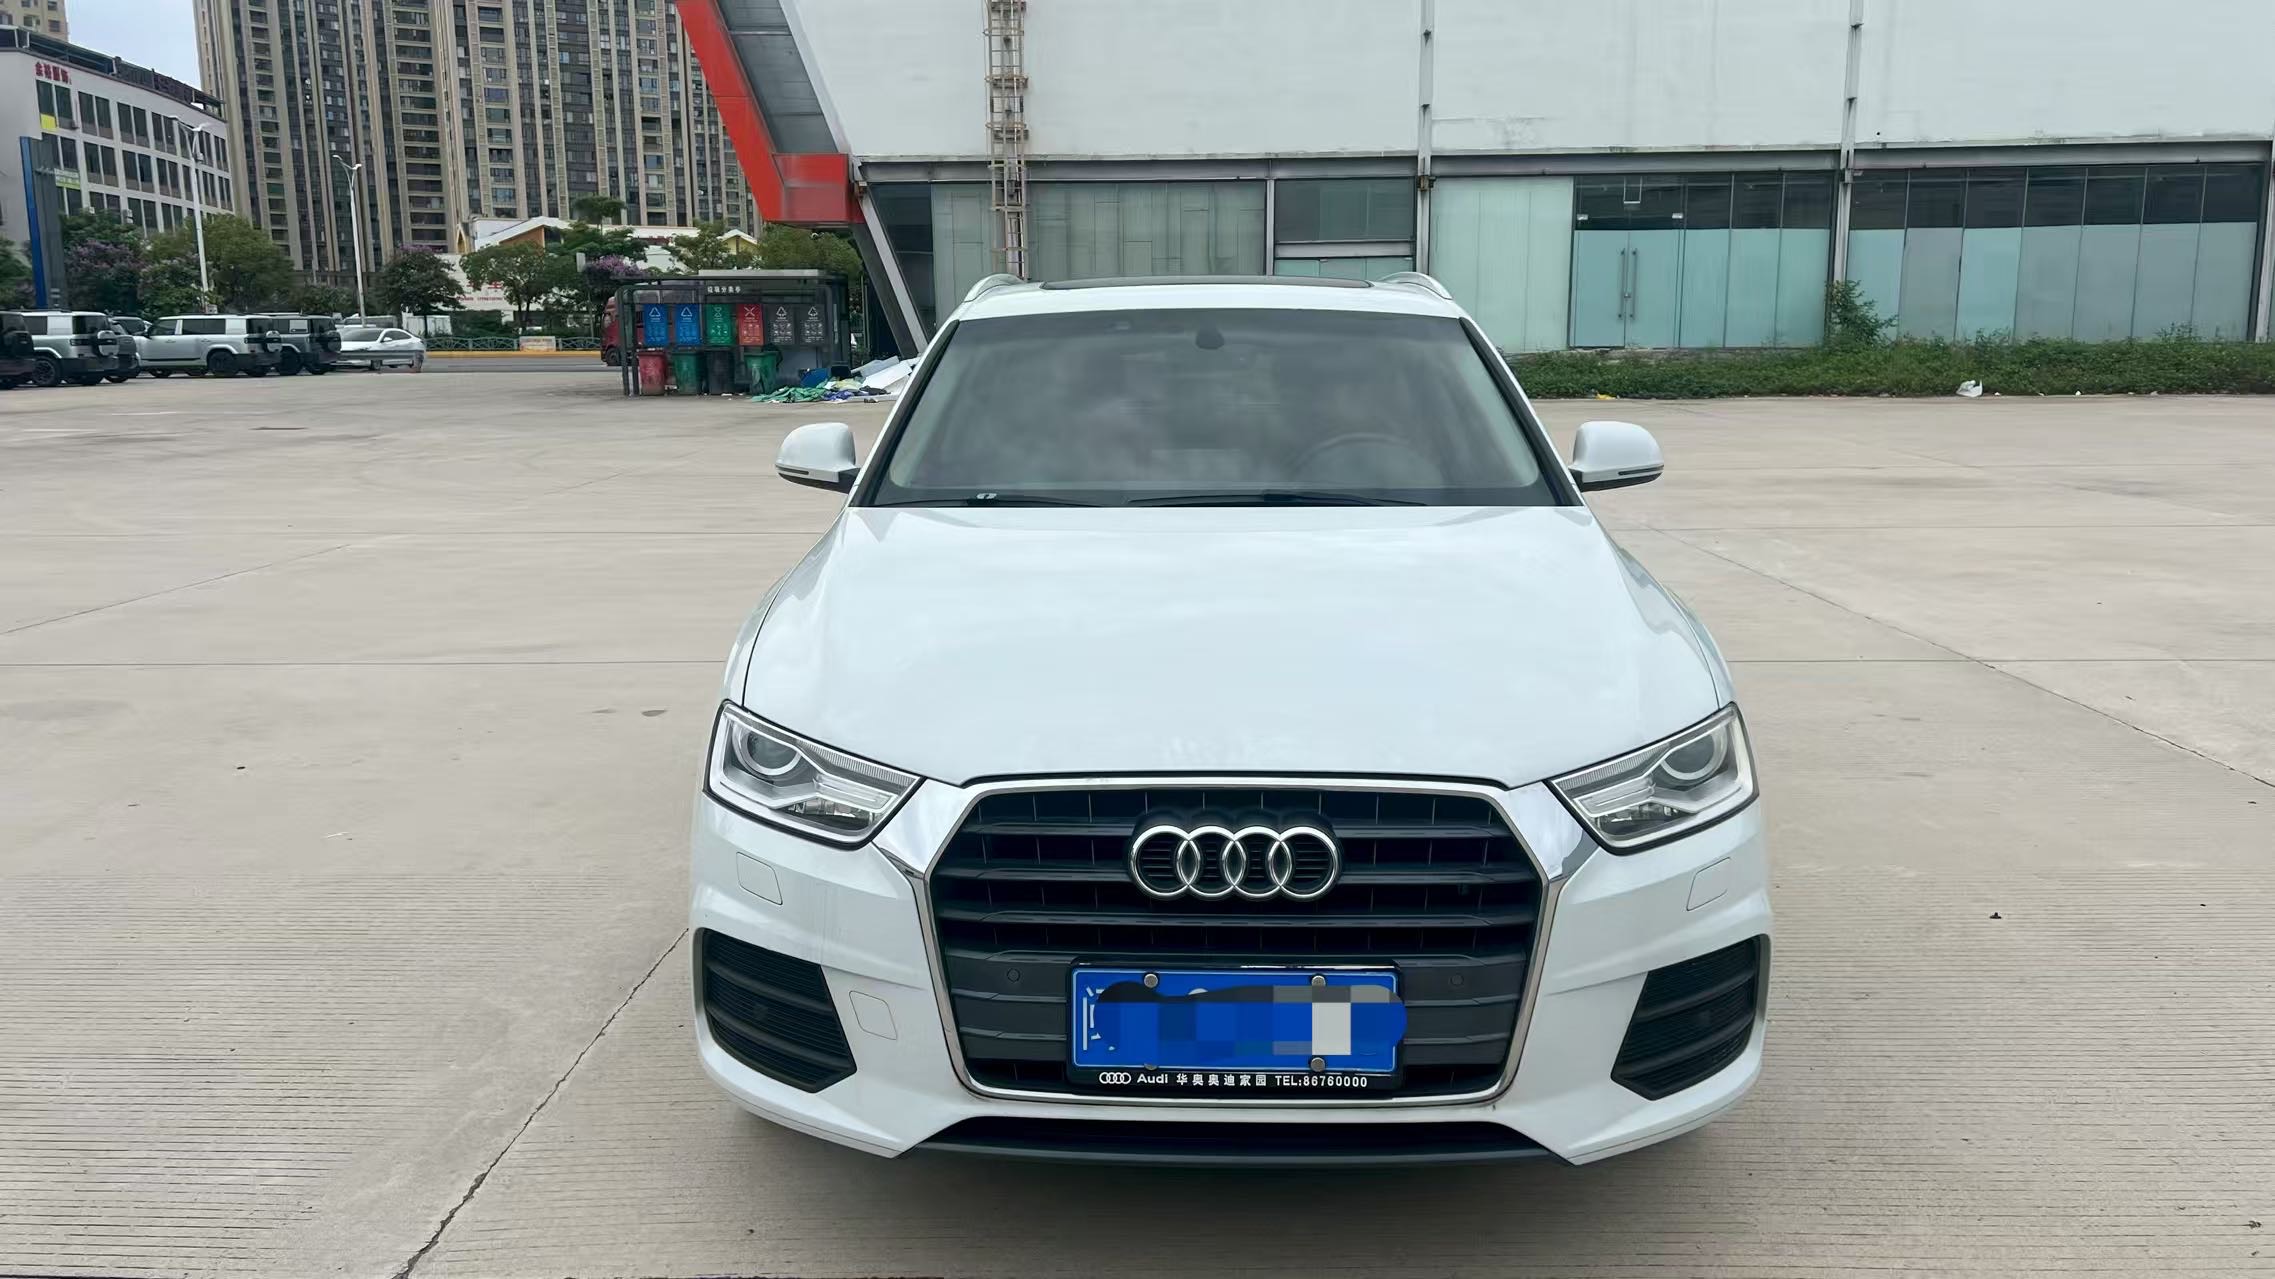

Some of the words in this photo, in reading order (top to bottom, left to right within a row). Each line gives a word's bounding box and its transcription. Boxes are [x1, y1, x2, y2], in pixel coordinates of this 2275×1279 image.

[1137, 1073, 1168, 1084] Audi
[1176, 1073, 1267, 1087] 华奥奥迪家园
[1275, 1075, 1368, 1088] TEL:86760000
